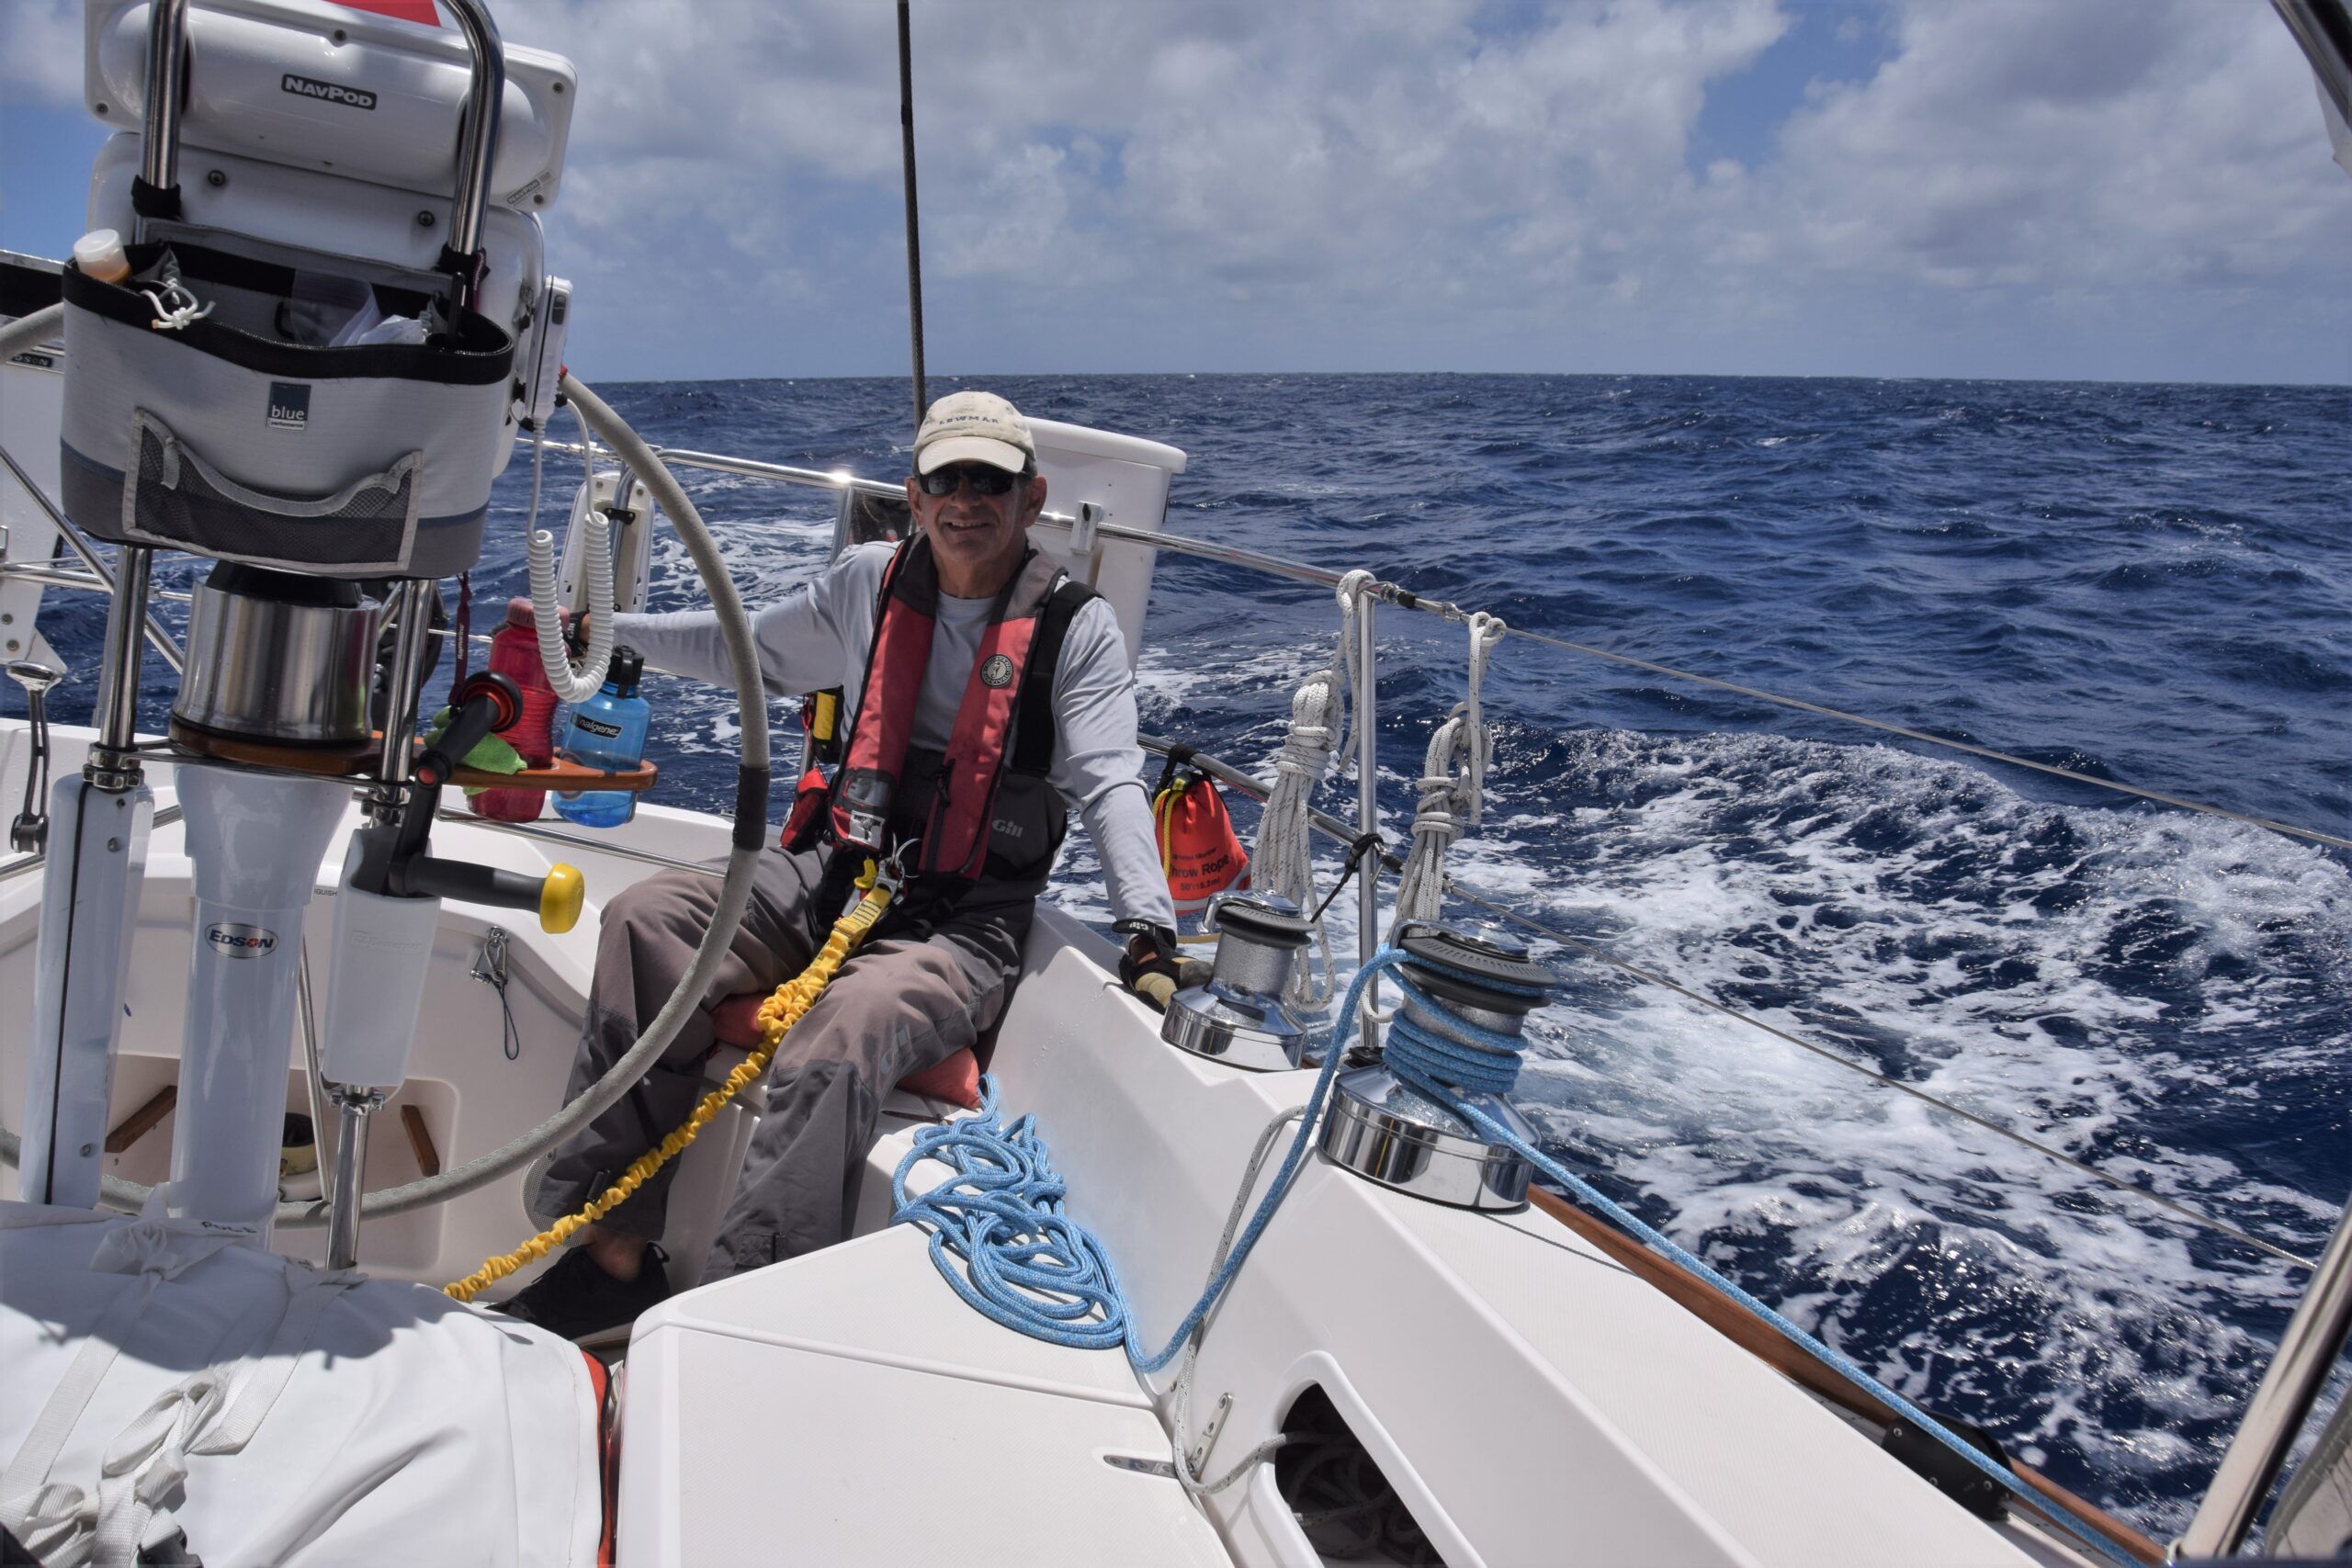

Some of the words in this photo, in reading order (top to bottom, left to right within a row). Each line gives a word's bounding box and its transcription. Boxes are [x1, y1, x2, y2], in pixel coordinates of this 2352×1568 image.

[271, 404, 305, 420] blue
[579, 719, 618, 736] nalgene
[992, 819, 1023, 838] Gill
[1170, 864, 1198, 878] hrow
[1202, 854, 1229, 875] Rope
[209, 930, 274, 949] EDSON
